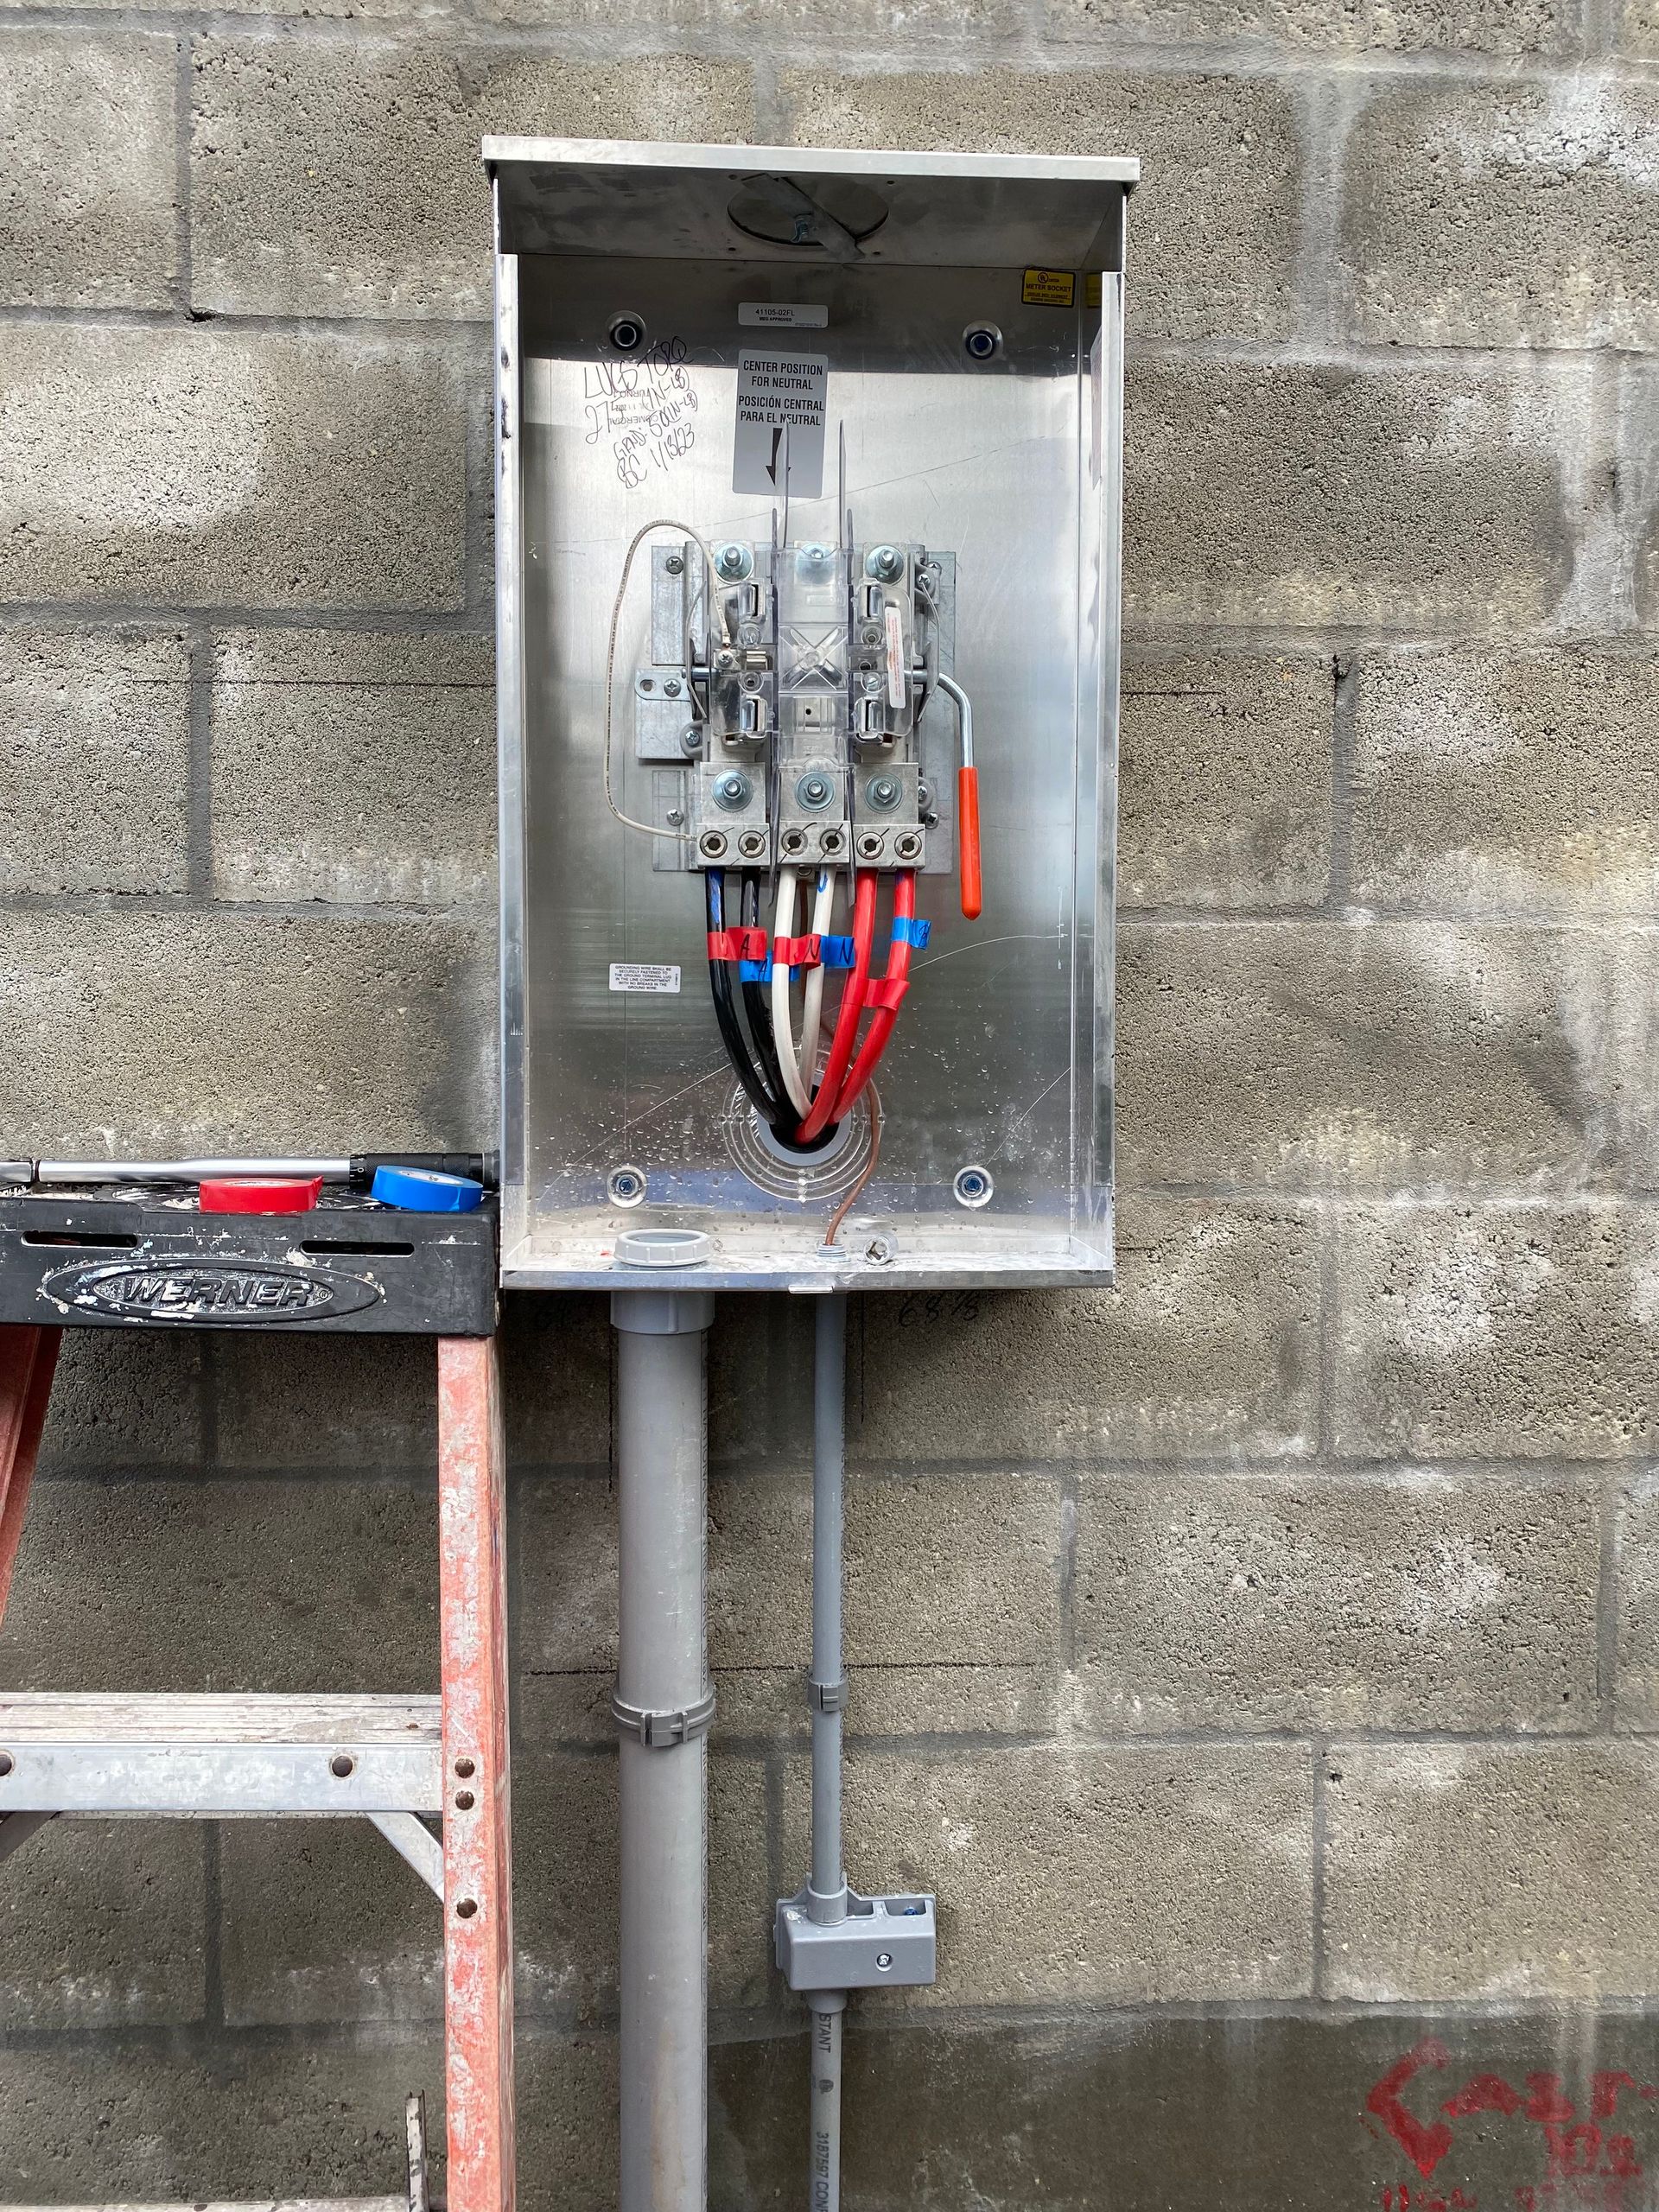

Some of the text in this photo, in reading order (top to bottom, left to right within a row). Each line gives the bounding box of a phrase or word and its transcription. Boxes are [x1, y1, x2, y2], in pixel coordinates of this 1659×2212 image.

[743, 360, 823, 375] CENTER POSITION
[751, 375, 813, 390] FOR NEUTRAL
[739, 395, 824, 411] POSICIÓN CENTRAL
[741, 410, 821, 426] PARA EL NEUTRAL
[741, 933, 751, 951] A
[804, 938, 821, 960] N
[839, 938, 854, 964] N
[124, 1275, 314, 1306] WERNER
[819, 2012, 832, 2053] STANT
